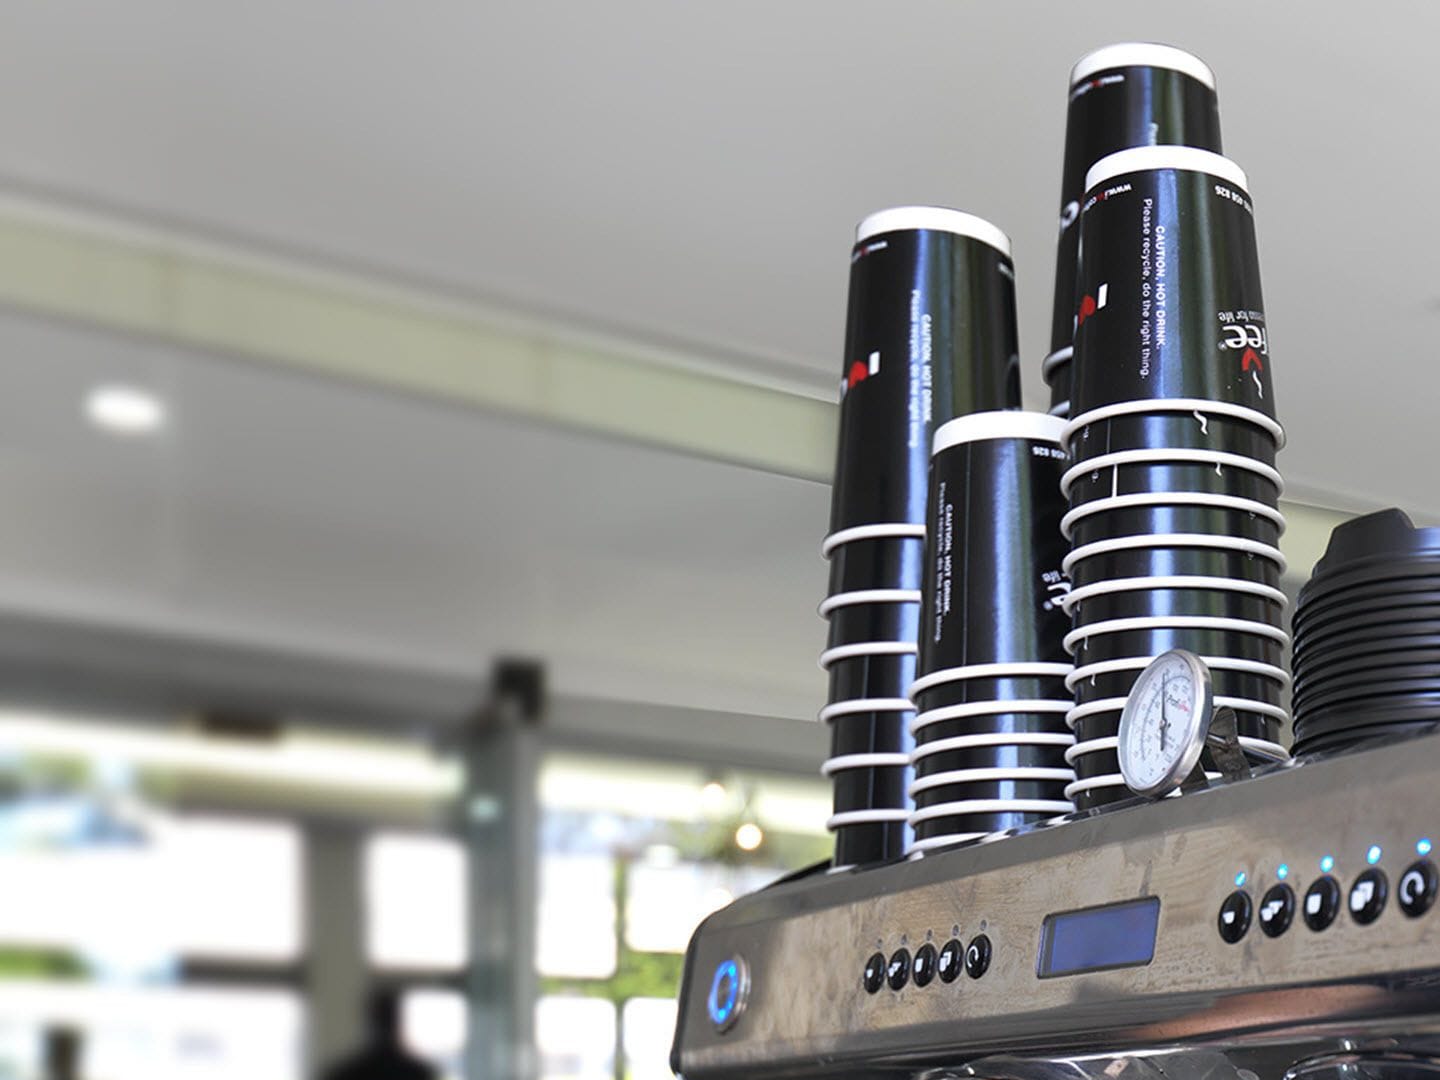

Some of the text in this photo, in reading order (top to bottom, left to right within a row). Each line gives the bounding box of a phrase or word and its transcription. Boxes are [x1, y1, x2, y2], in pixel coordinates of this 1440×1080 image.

[1143, 198, 1153, 235] Please
[1155, 225, 1166, 280] CAUTION,
[1142, 283, 1151, 298] do
[1156, 283, 1166, 308] HOT
[1142, 300, 1151, 318] the
[1140, 320, 1151, 346] right
